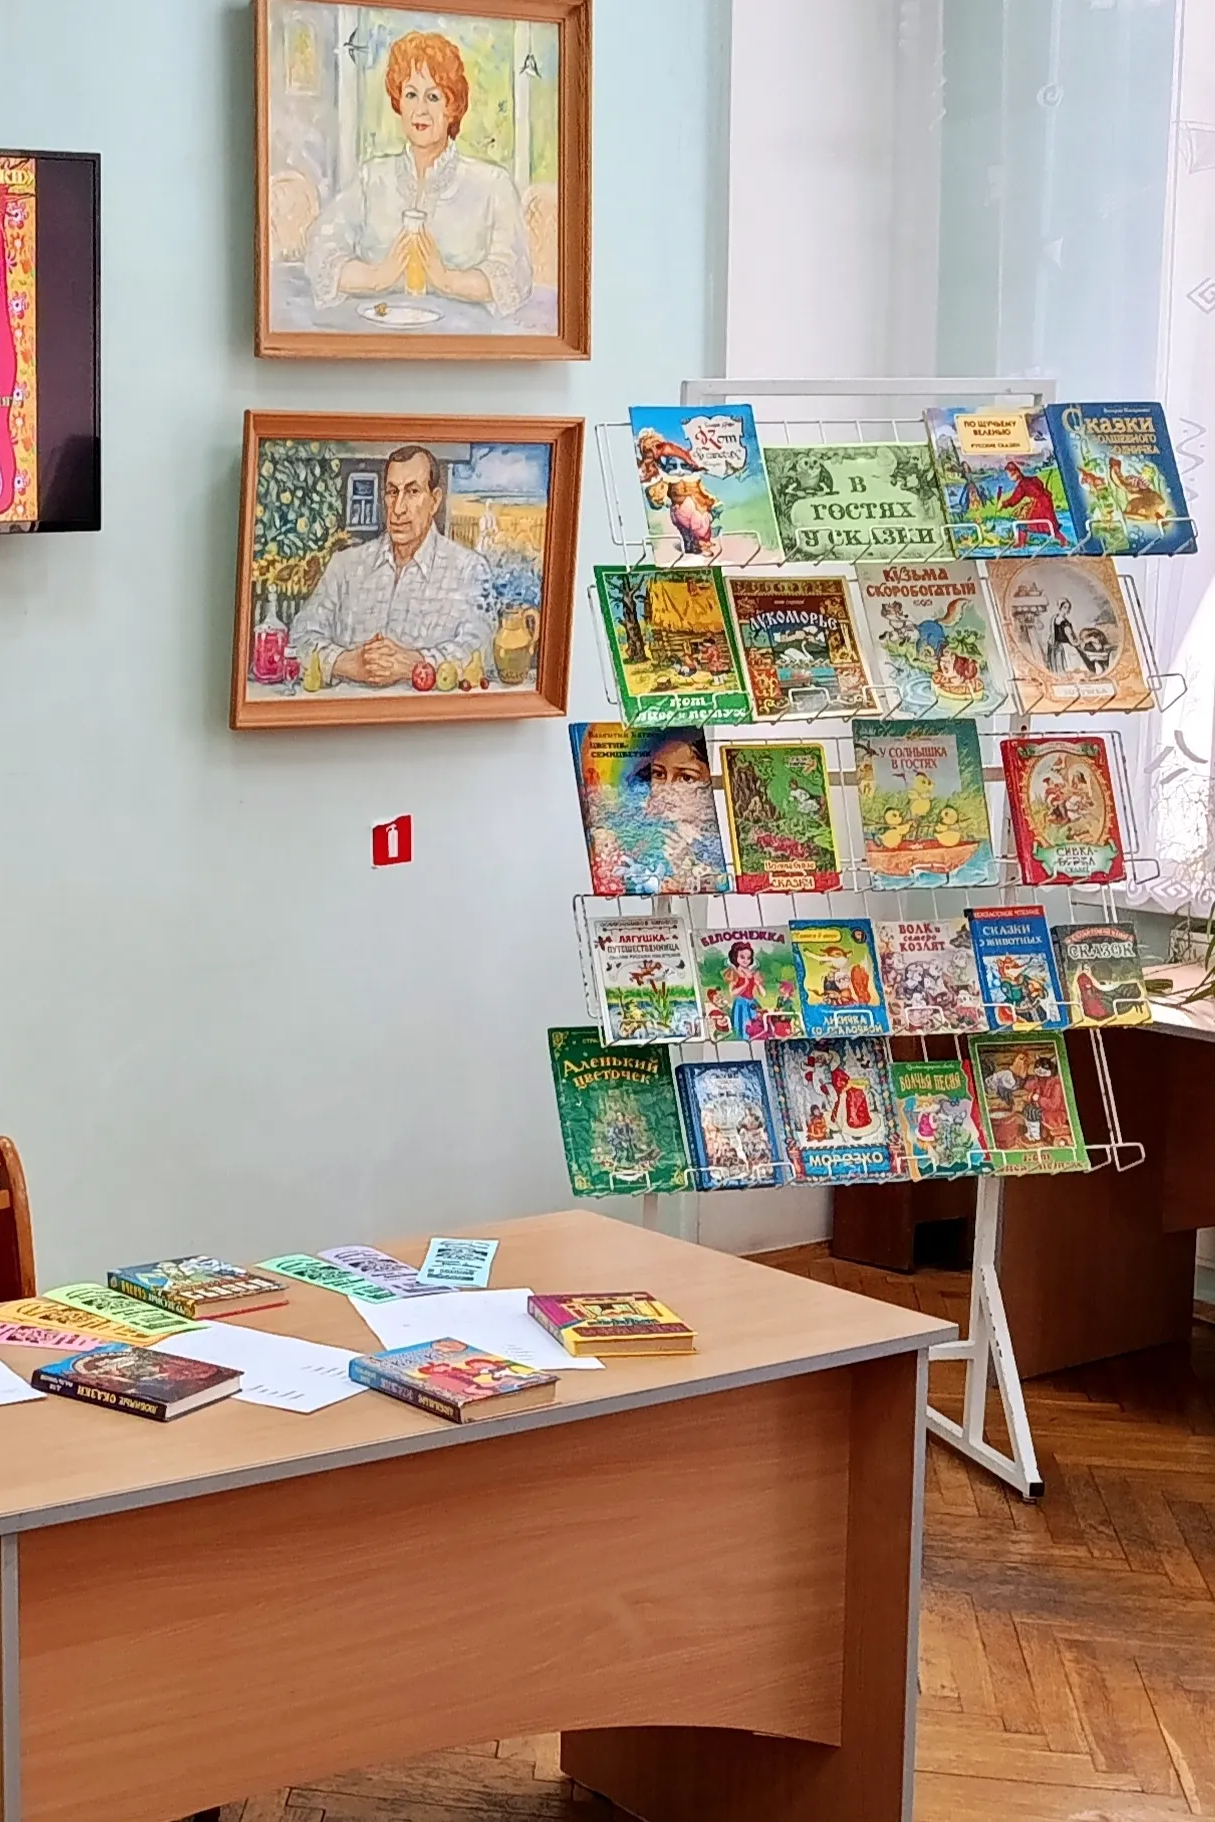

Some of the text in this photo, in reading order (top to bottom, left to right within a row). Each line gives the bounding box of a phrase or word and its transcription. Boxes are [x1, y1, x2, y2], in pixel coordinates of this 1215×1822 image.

[1090, 433, 1157, 445] ОЛШЕБНОГО
[847, 475, 867, 493] В
[810, 501, 917, 521] ГОСТЯХ
[800, 527, 937, 547] У СКАЗКИ
[882, 566, 949, 584] КУЗЬМА
[866, 576, 976, 598] СКОРОБОГАТЫЙ
[749, 610, 838, 632] ЛУКОМОРЬЕ
[879, 746, 948, 758] У СОЛНЫШКА
[891, 758, 938, 769] В ГОСТЯХ
[898, 923, 933, 935] ВОЛК
[982, 924, 1031, 936] СКАЗКИ
[700, 930, 785, 947] БЕЛОСНЕЖКА
[899, 941, 946, 952] КОЗЛЯТ
[986, 936, 1043, 947] ЖИВОТНЫХ
[607, 943, 680, 954] ПУТЕШЕСТВЕННИЦА
[1068, 941, 1136, 960] СКАЗОК
[562, 1056, 659, 1079] Аленький
[899, 1071, 961, 1092] ВОЛЧЬЯ ПЕСНЯ
[809, 1151, 884, 1167] МОРОЗКО
